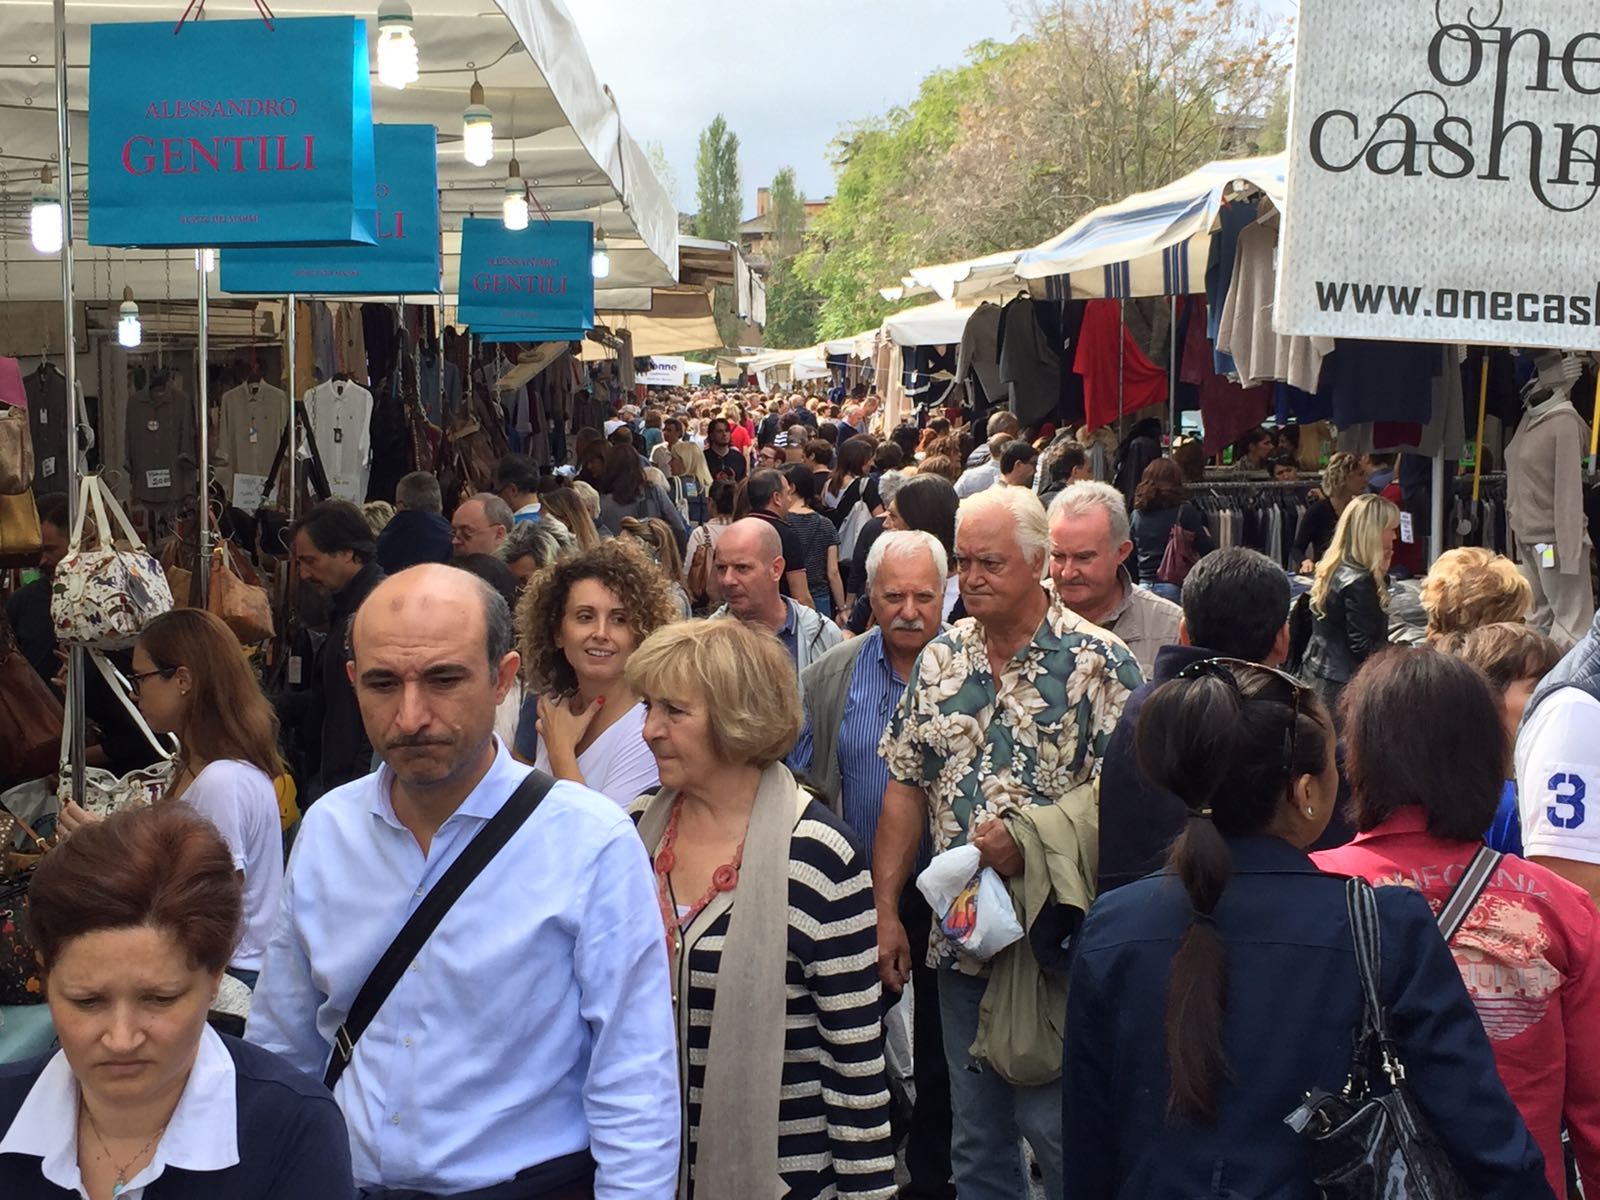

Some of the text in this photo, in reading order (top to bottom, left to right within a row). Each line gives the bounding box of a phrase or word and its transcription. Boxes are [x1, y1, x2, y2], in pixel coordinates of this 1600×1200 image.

[1428, 0, 1600, 95] one
[144, 98, 297, 119] ALESSANDRO
[121, 135, 318, 176] GENTILI
[473, 271, 568, 295] GENTILI
[651, 363, 677, 371] onne
[1547, 773, 1586, 829] 3
